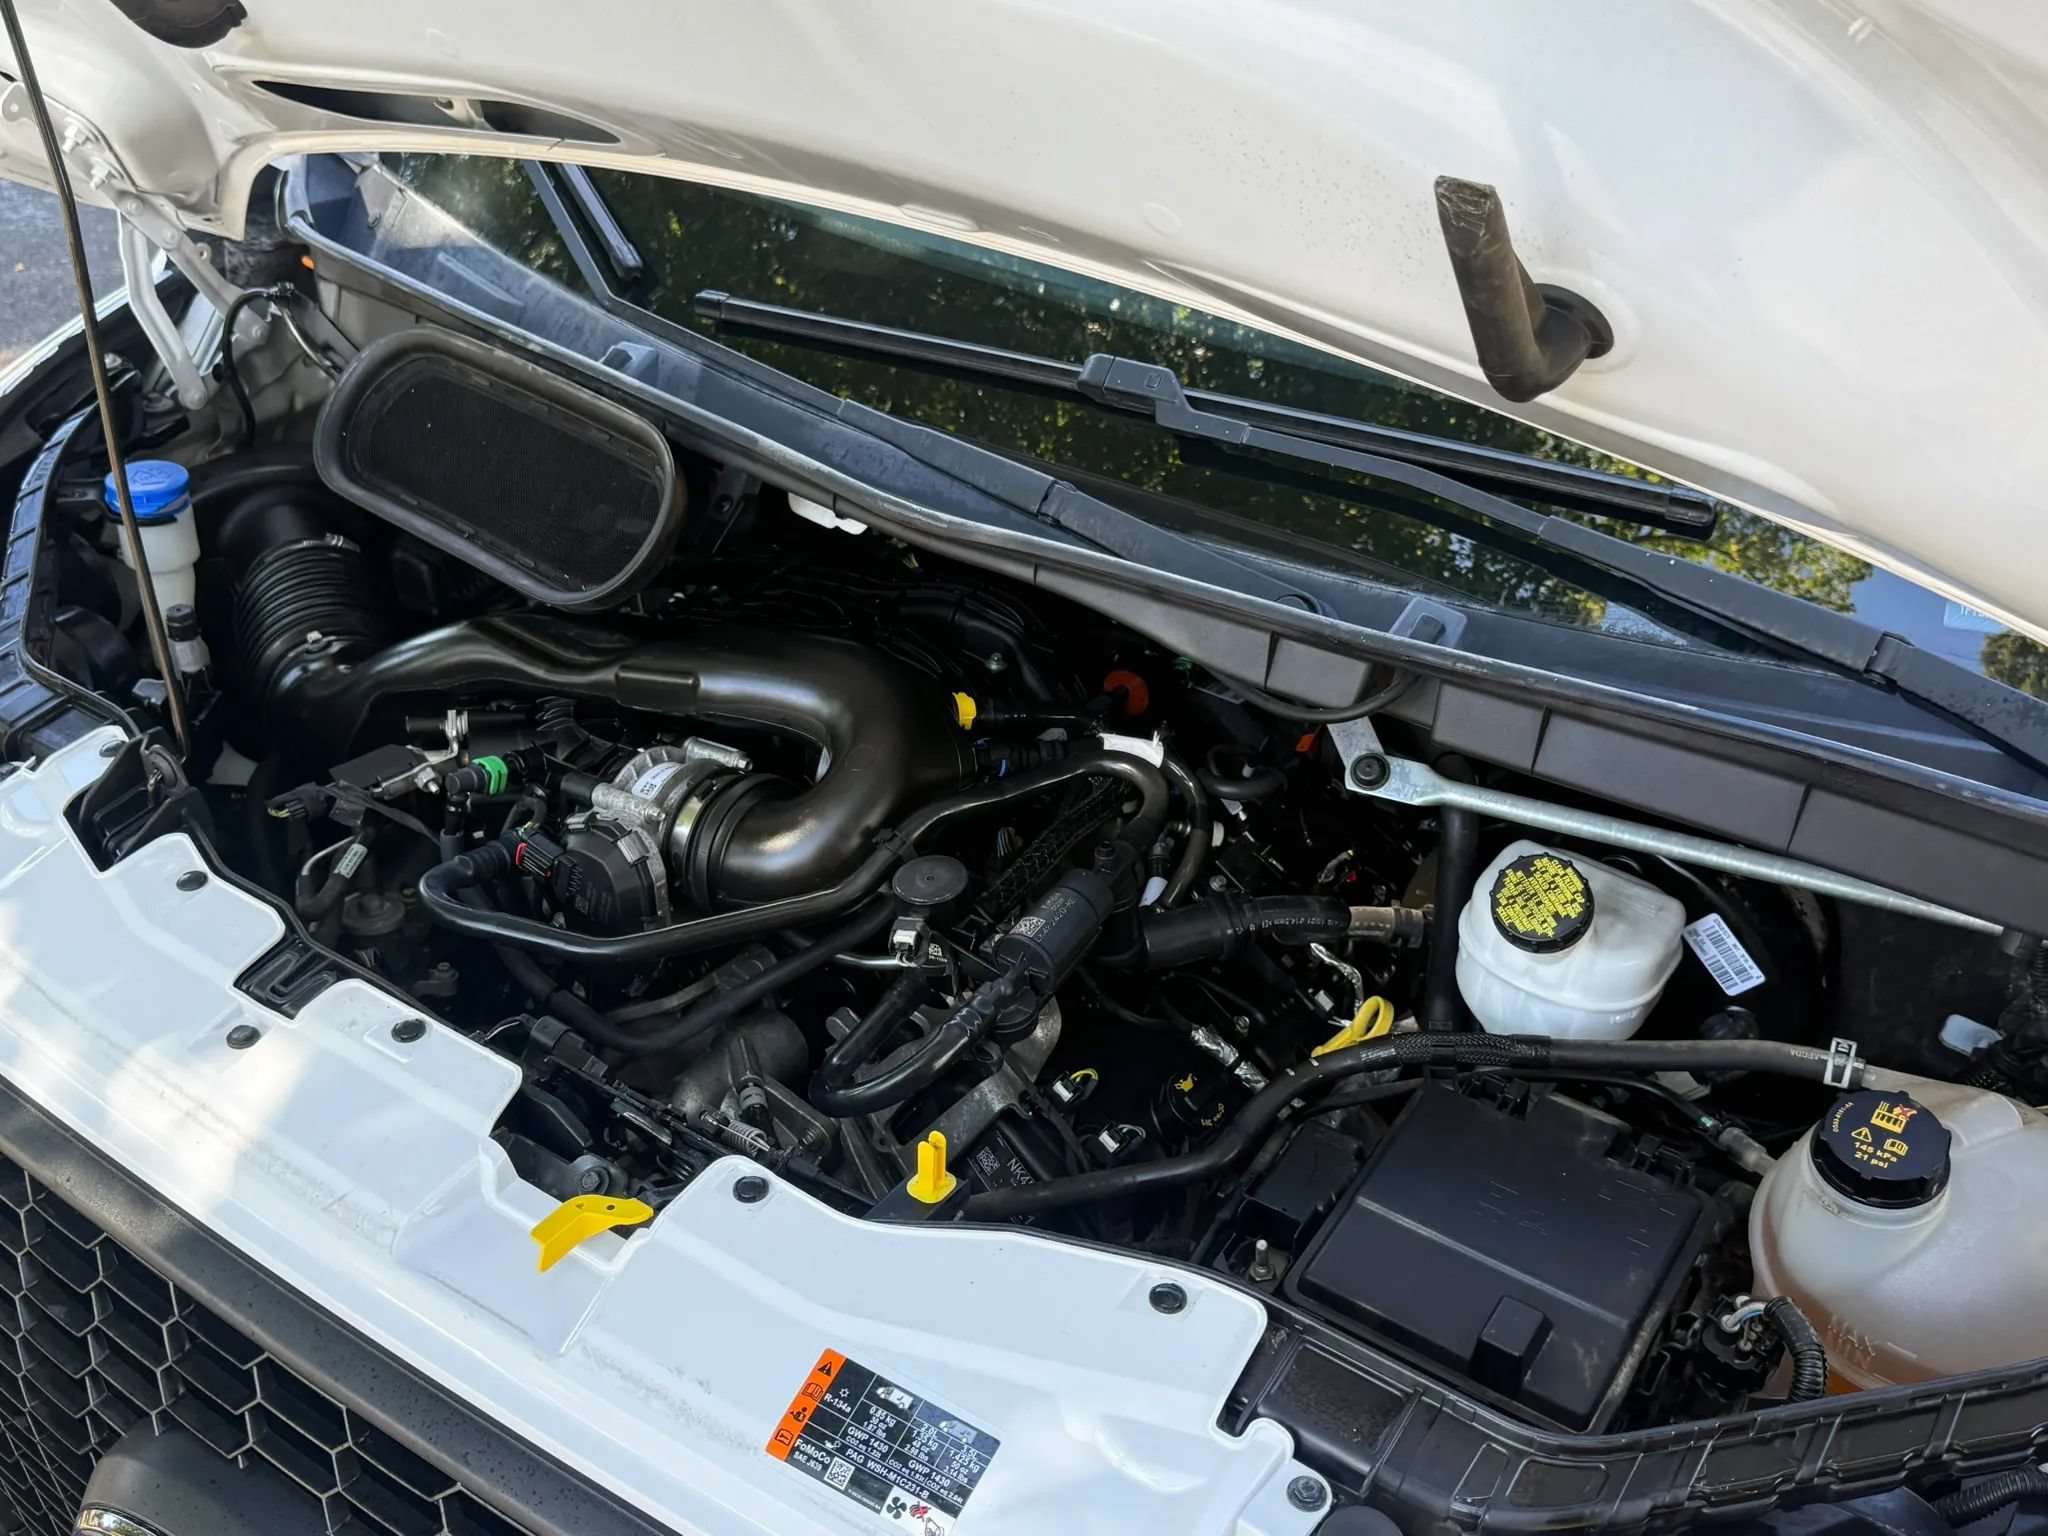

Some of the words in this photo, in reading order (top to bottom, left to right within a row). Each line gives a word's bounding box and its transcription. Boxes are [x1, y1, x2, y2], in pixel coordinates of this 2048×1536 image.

[1551, 859, 1565, 876] CLEAN
[1575, 892, 1585, 904] CAP
[1853, 1141, 1874, 1153] 145
[1876, 1149, 1898, 1162] kPa
[1854, 1151, 1868, 1161] 21
[1870, 1157, 1889, 1169] psi
[823, 1392, 852, 1413] R-134a
[868, 1406, 886, 1420] 0.85
[883, 1415, 897, 1427] kg
[869, 1416, 879, 1425] 30
[877, 1422, 887, 1430] oz
[862, 1421, 877, 1432] 1.87
[875, 1428, 887, 1438] lbs
[920, 1423, 939, 1438] 2.0L
[845, 1435, 859, 1446] CO2
[857, 1442, 867, 1451] eq
[846, 1426, 869, 1442] GWP
[868, 1437, 889, 1453] 1430
[911, 1429, 928, 1444] 1.35
[925, 1438, 938, 1451] kg
[911, 1439, 921, 1448] 48
[919, 1444, 929, 1453] oz
[793, 1438, 832, 1464] FoMoCo
[793, 1450, 808, 1463] SAE
[806, 1458, 823, 1471] J639
[903, 1443, 919, 1456] 2.98
[917, 1451, 929, 1462] lbs
[960, 1445, 979, 1460] 3.5L
[888, 1458, 902, 1470] CO2
[900, 1467, 910, 1475] eq
[947, 1449, 969, 1466] 1.425
[966, 1460, 981, 1474] kg
[950, 1461, 960, 1469] 50
[958, 1466, 969, 1474] oz
[845, 1449, 865, 1464] PAG
[866, 1460, 929, 1499] WSH-M1C231-B
[907, 1459, 929, 1476] GWP
[928, 1470, 951, 1487] 1430
[942, 1465, 957, 1477] 3.14
[956, 1473, 969, 1483] lbs
[925, 1479, 940, 1491] CO2
[937, 1487, 948, 1496] eq
